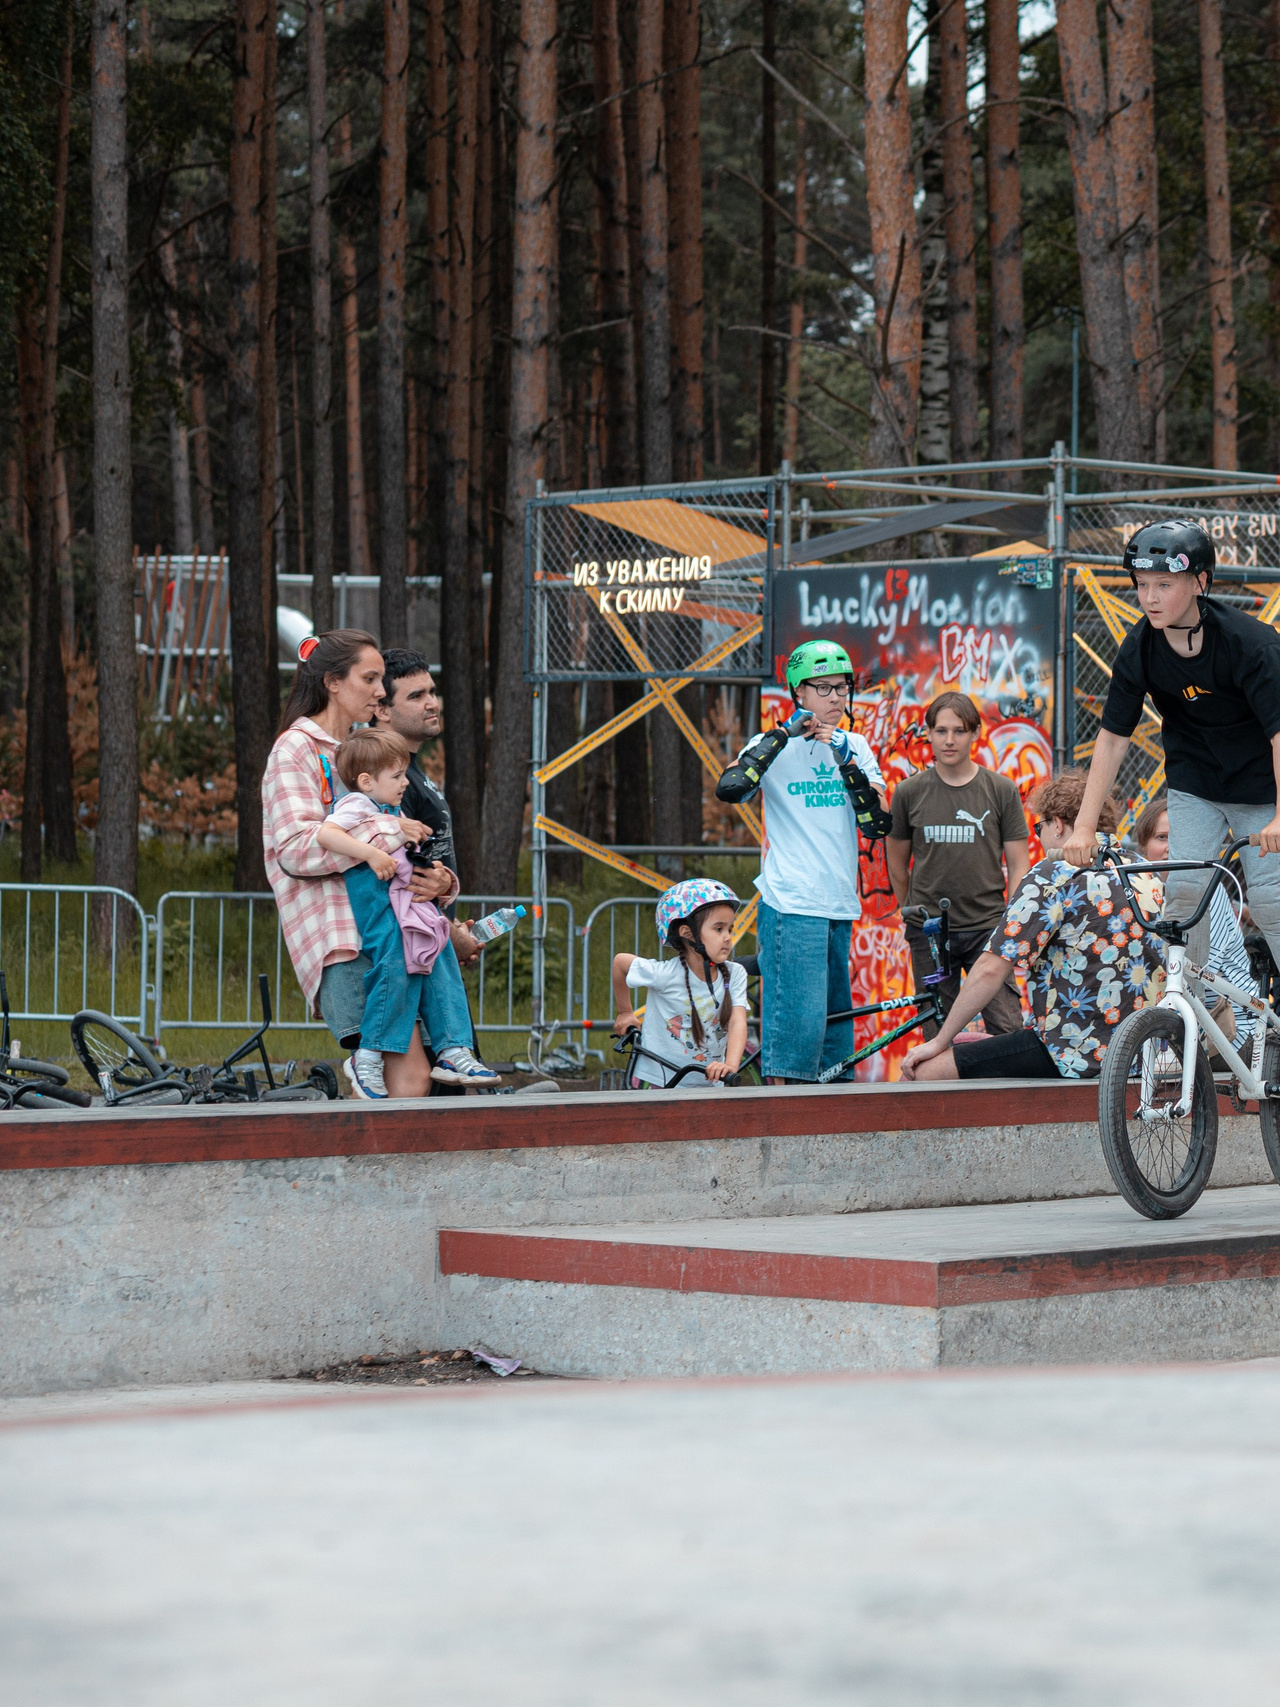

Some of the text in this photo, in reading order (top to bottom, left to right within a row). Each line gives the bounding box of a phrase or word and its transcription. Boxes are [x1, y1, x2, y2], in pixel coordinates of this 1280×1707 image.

[573, 555, 712, 587] ИЗ УВАЖЕНИЯ
[600, 587, 685, 615] К СКИМУ
[805, 793, 846, 808] KINGS
[923, 825, 975, 843] PUMA
